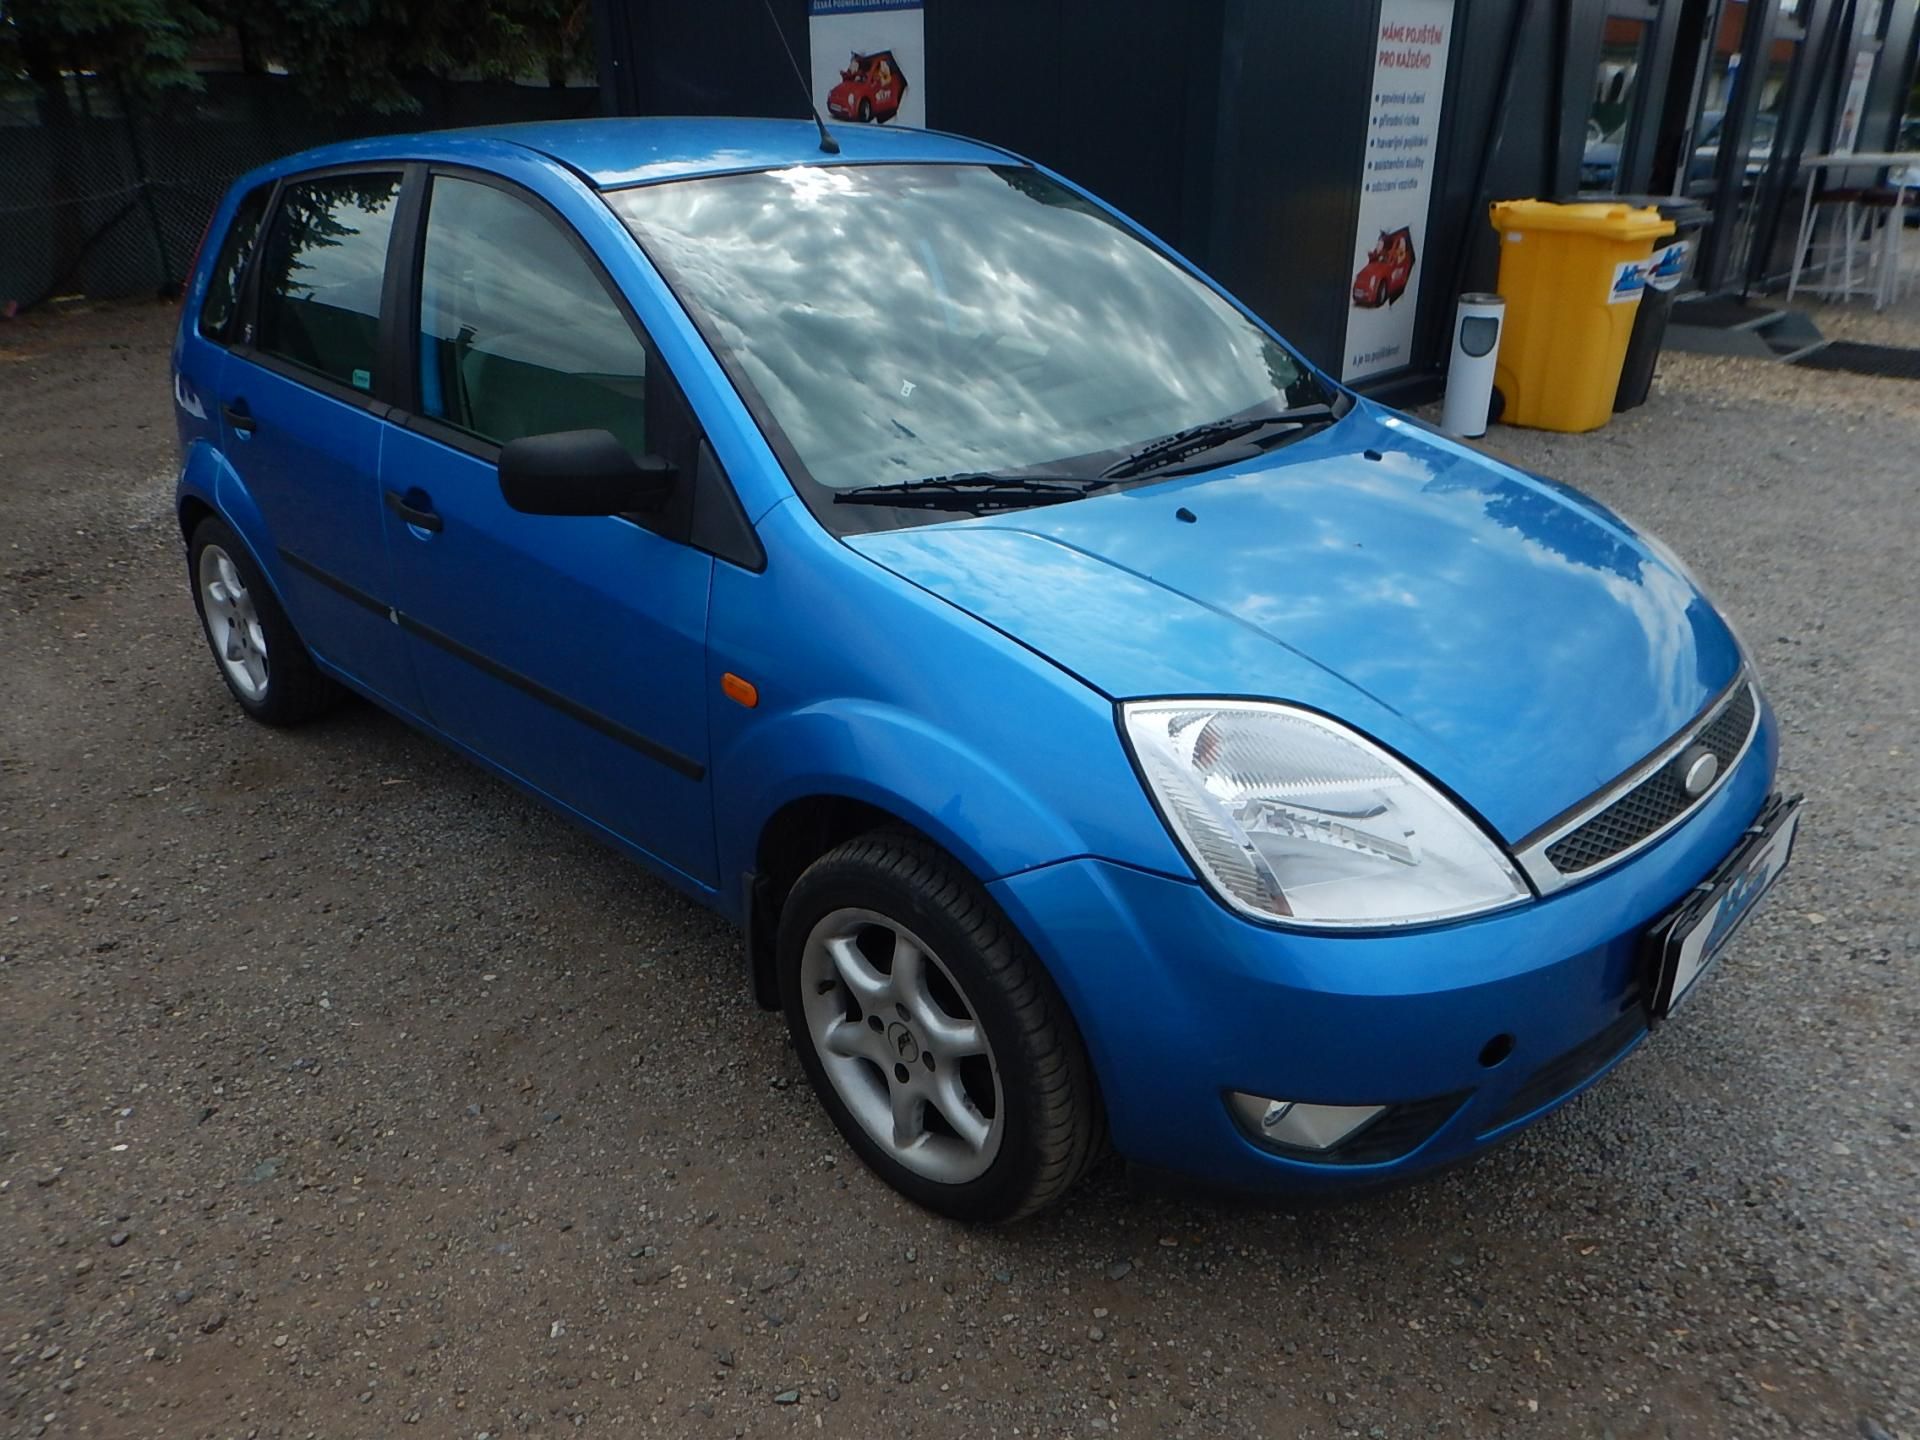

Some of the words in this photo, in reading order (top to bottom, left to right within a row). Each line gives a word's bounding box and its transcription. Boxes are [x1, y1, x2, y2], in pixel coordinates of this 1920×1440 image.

[1381, 21, 1404, 43] MÁME
[1378, 50, 1395, 67] PRO
[1396, 47, 1431, 69] KAŽDÉHO
